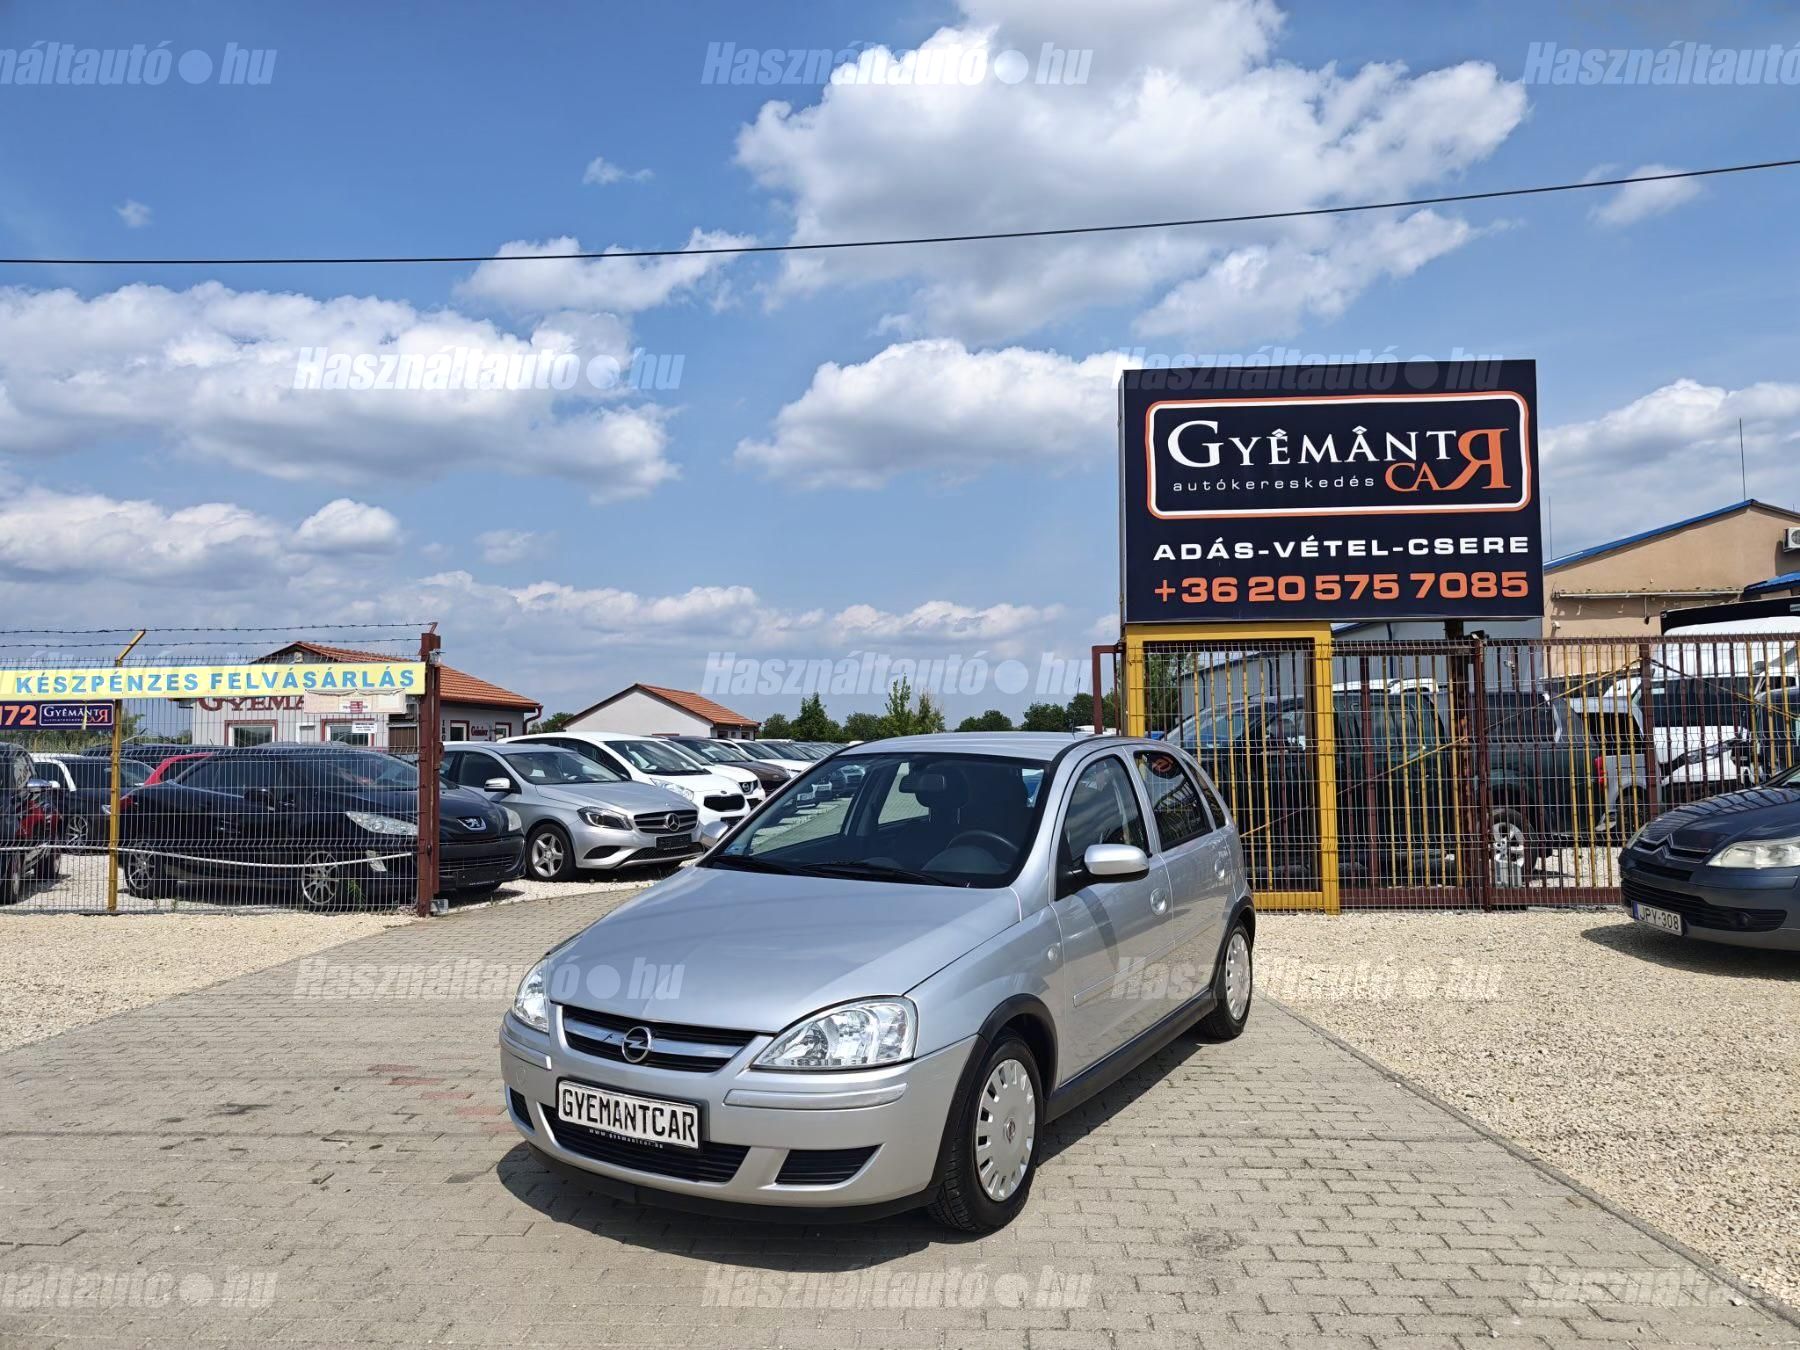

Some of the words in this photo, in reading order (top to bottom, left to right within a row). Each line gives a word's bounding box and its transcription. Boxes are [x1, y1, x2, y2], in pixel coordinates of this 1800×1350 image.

[1173, 475, 1375, 491] autókereskedés
[1153, 536, 1529, 560] ADÁS-VÉTEL-CSERE
[1154, 578, 1237, 602] +36
[1248, 576, 1306, 601] 20
[1315, 574, 1399, 600] 575
[1410, 571, 1529, 598] 7085
[16, 672, 198, 694] KÉSZPÉNZES
[210, 666, 414, 690] FELVÁSÁRLÁS
[0, 705, 36, 726] 72
[1640, 906, 1679, 930] JPY-308
[562, 1088, 696, 1143] GYEMANTCAR
